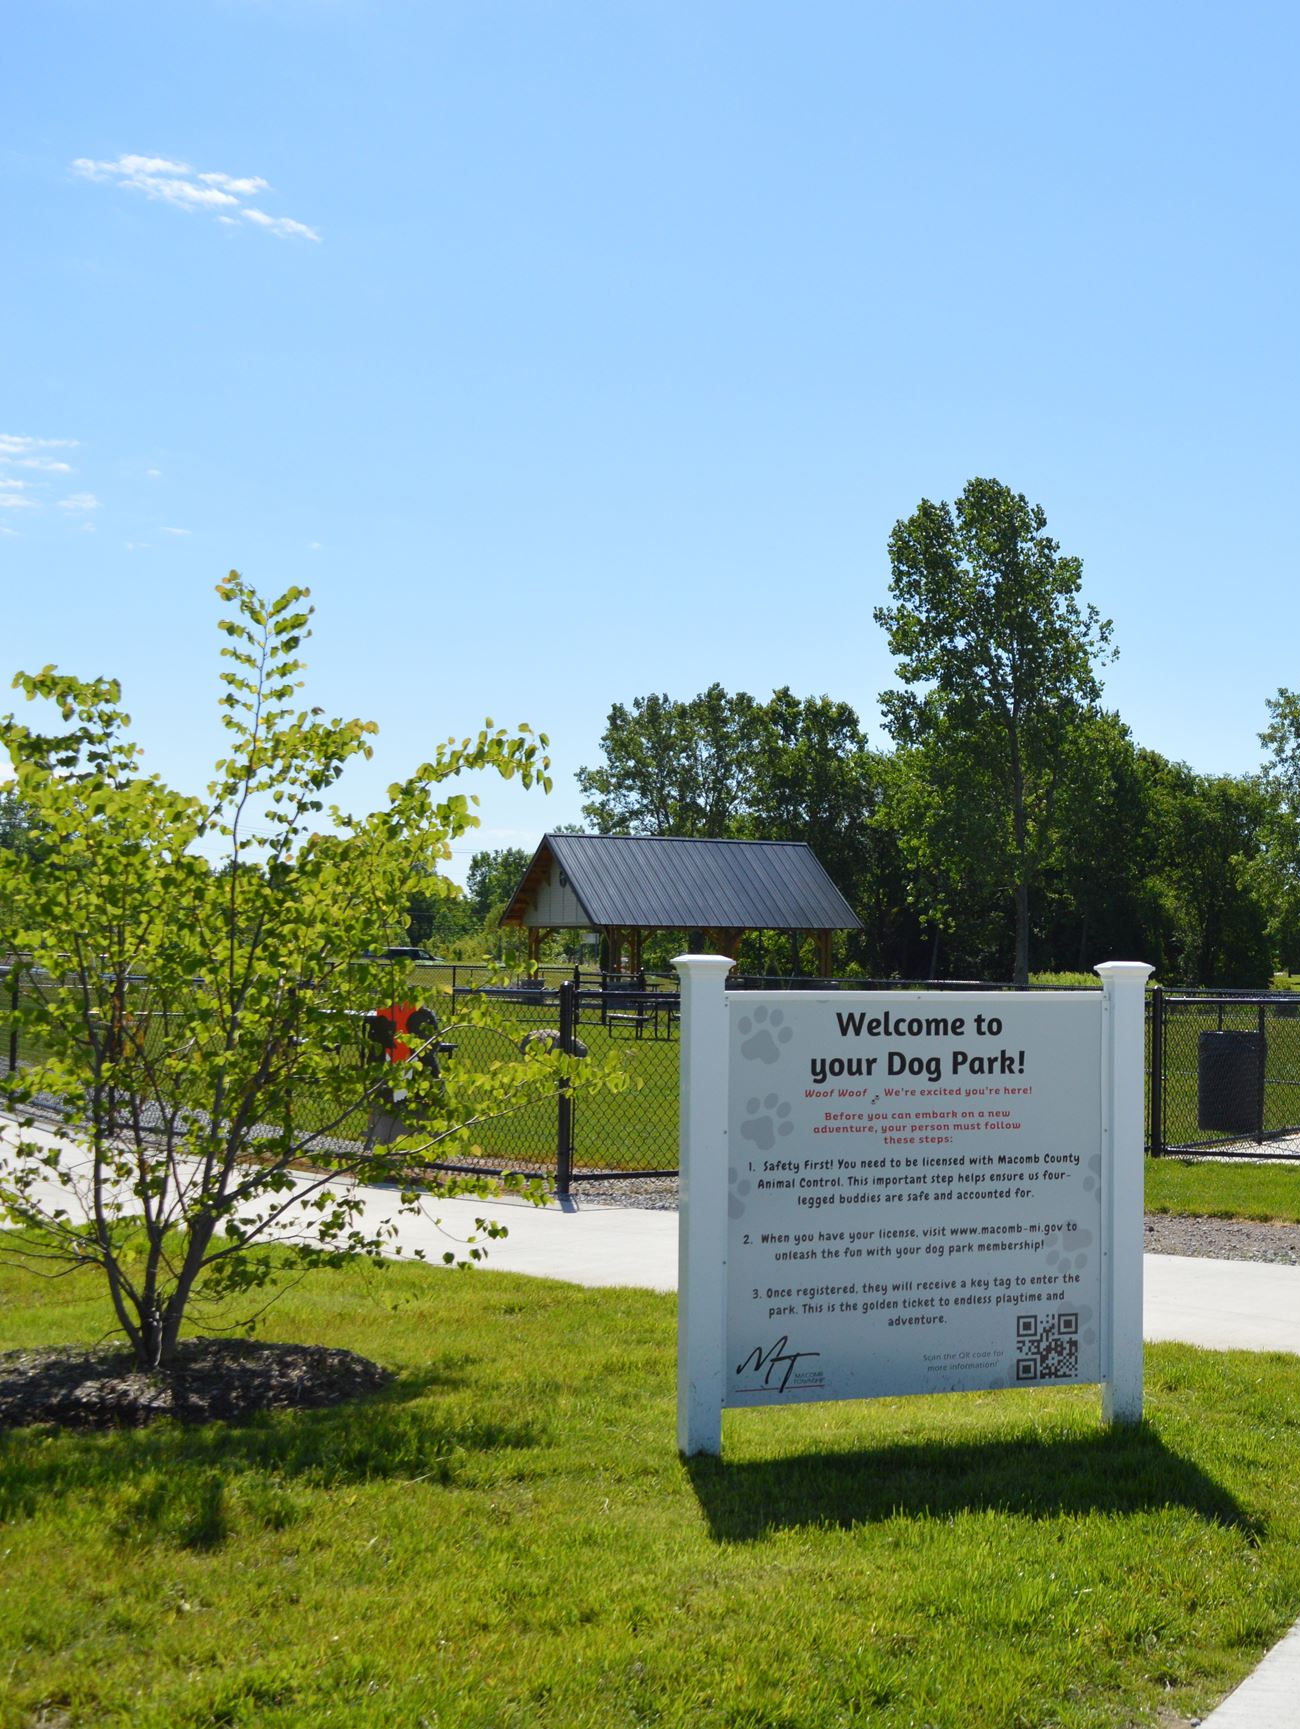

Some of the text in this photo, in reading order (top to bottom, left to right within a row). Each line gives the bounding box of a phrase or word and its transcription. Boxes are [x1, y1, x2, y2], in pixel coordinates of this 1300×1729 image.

[836, 1010, 1003, 1036] Welcome to
[810, 1049, 1026, 1084] your Dog Park!
[804, 1086, 1032, 1098] Woof Woof We're excited you're here!
[824, 1112, 864, 1121] Before
[867, 1112, 888, 1122] you
[892, 1112, 911, 1120] can
[914, 1110, 958, 1120] embark
[813, 1121, 1021, 1134] adventure, your person must follow
[884, 1135, 952, 1145] these steps:
[764, 1160, 800, 1174] Safety
[804, 1160, 833, 1170] First!
[838, 1158, 856, 1169] You
[860, 1158, 886, 1168] need
[890, 1158, 901, 1168] to
[906, 1157, 918, 1167] be
[922, 1156, 965, 1166] licensed
[969, 1156, 994, 1165] with
[998, 1154, 1040, 1164] Macomb
[1044, 1153, 1080, 1166] County
[758, 1170, 1072, 1189] Animal Control. This important step helps ensure us four-
[798, 1188, 1034, 1208] legged buddies are safe and accounted for.
[743, 1234, 752, 1245] 2.
[761, 1234, 790, 1244] When
[794, 1234, 814, 1246] you
[818, 1232, 845, 1242] have
[850, 1231, 874, 1243] your
[922, 1226, 946, 1237] visit
[950, 1222, 1062, 1236] www.macomb-mi.gov
[1066, 1222, 1078, 1232] to
[775, 1240, 1044, 1262] unleash the fun with your dog park membership!
[752, 1289, 762, 1299] 3.
[766, 1288, 792, 1298] Once
[862, 1282, 888, 1295] they
[892, 1282, 912, 1292] will
[916, 1280, 956, 1290] receive
[960, 1280, 966, 1288] a
[971, 1278, 990, 1290] key
[993, 1278, 1012, 1290] tag
[1015, 1276, 1026, 1286] to
[1030, 1274, 1058, 1284] enter
[1062, 1273, 1080, 1283] the
[768, 1291, 1065, 1318] park. This is the golden ticket to endless playtime and
[888, 1315, 947, 1326] adventure.
[959, 1352, 970, 1360] QR
